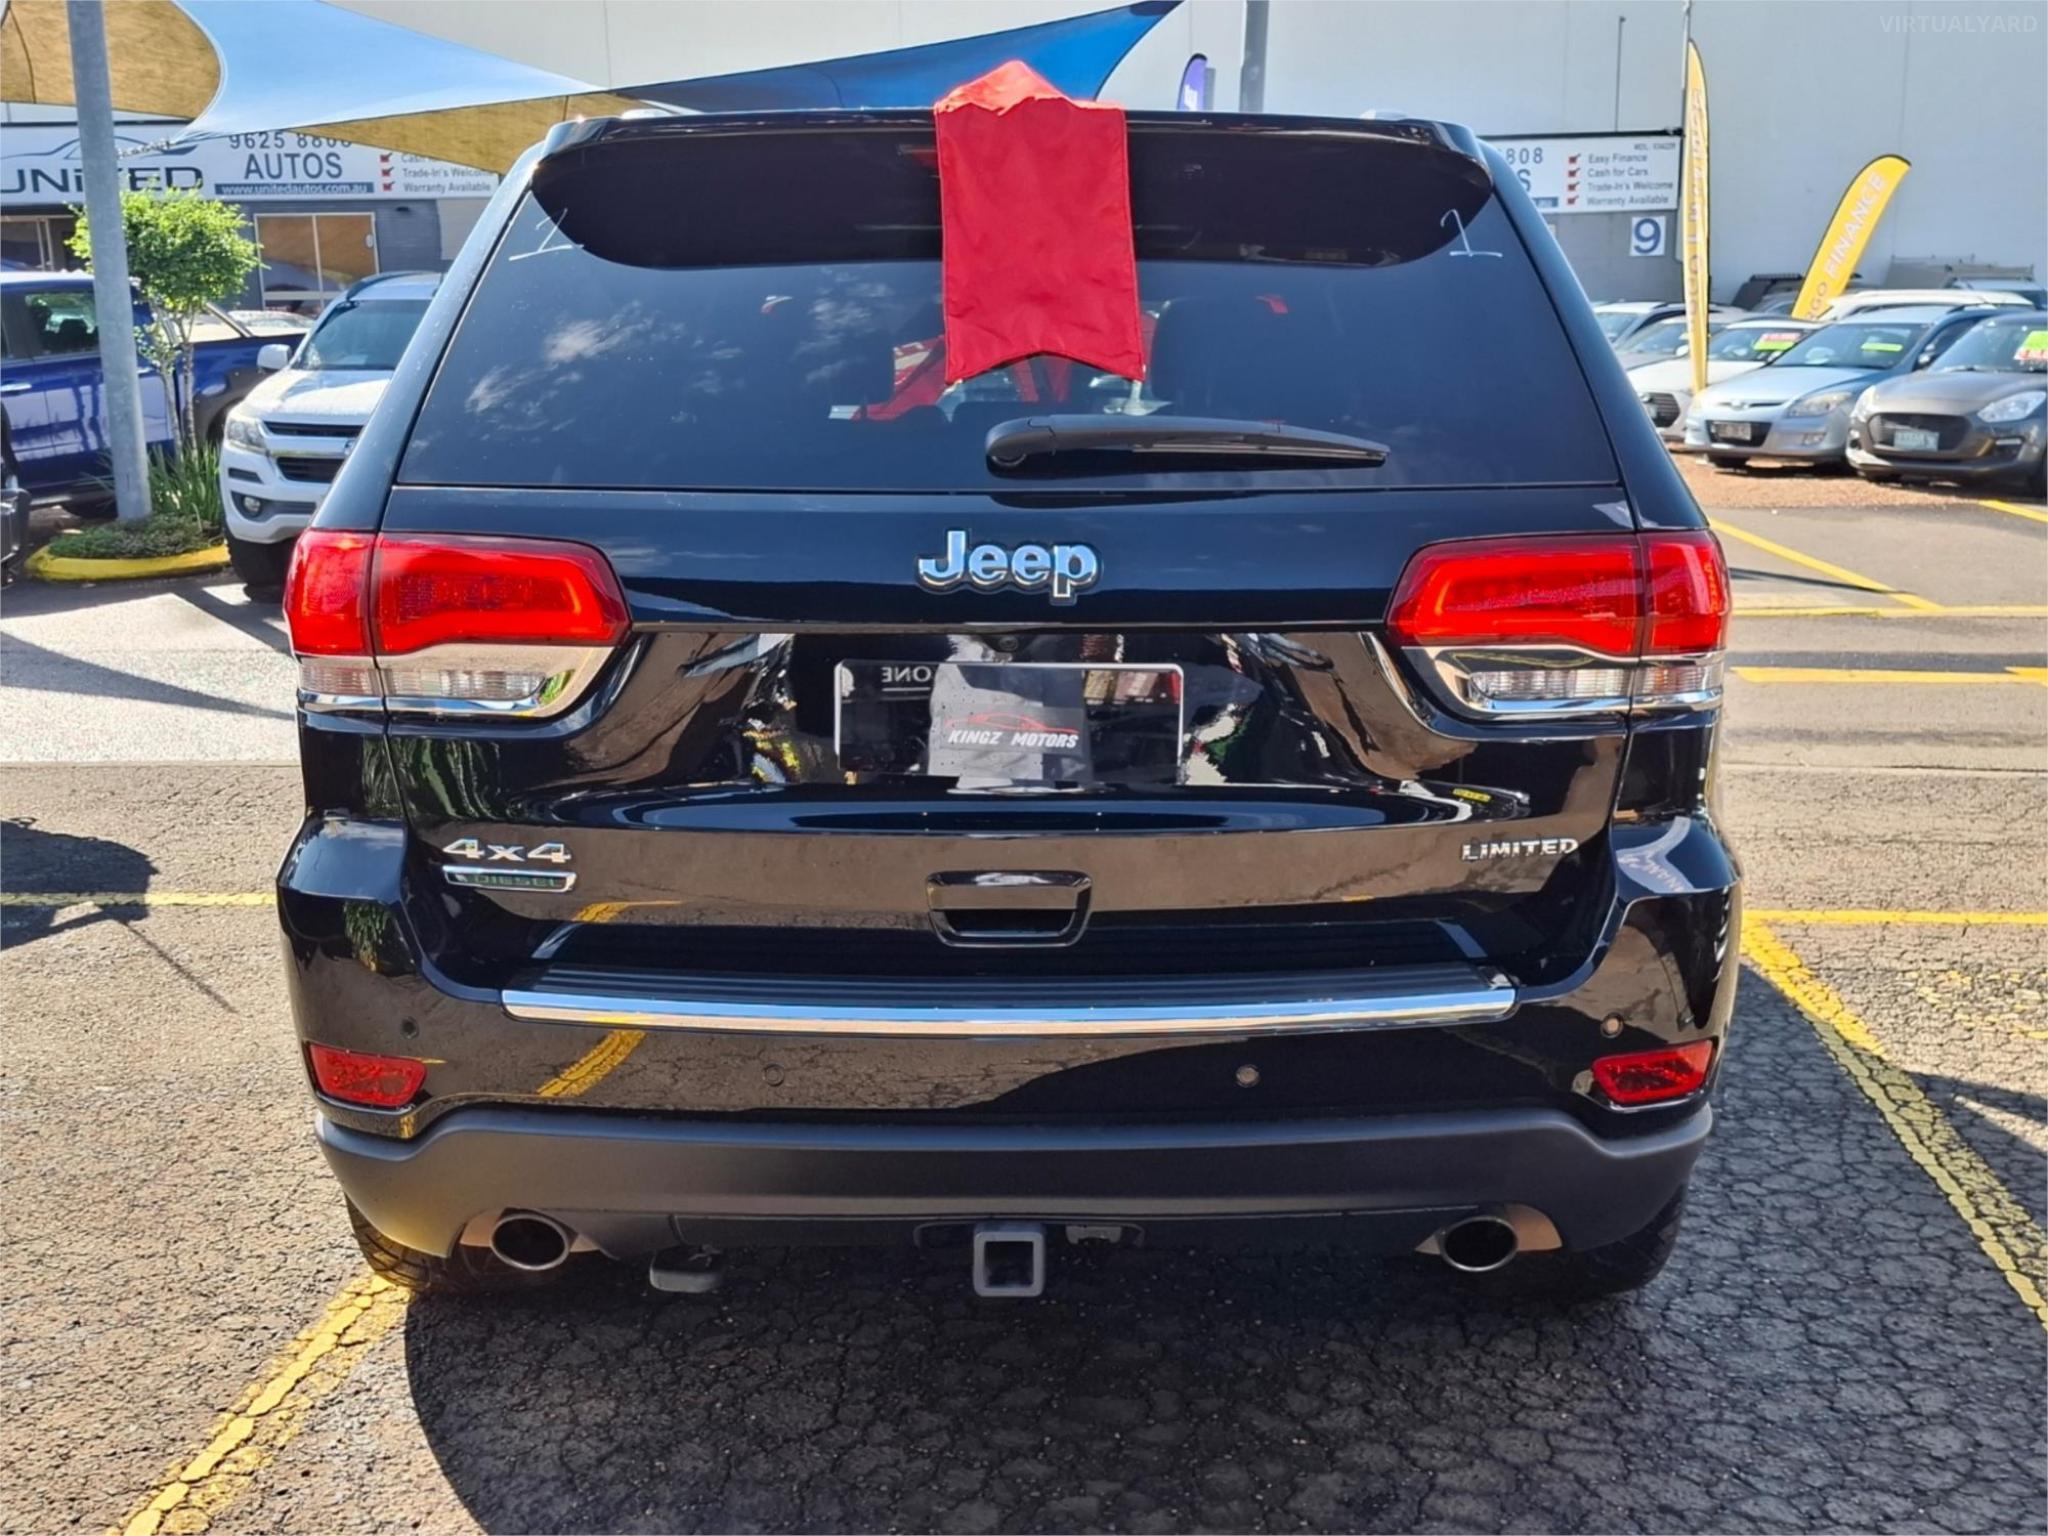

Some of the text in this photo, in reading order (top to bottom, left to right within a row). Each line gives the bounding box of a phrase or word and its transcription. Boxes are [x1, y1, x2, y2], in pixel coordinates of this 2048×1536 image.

[244, 152, 343, 180] AUTOS
[1612, 153, 1648, 163] Finance
[1587, 168, 1611, 178] Cash
[1627, 167, 1649, 177] Cars
[403, 181, 492, 195] Warranty Available
[1632, 181, 1674, 191] Welcome
[1628, 195, 1670, 205] Available
[1633, 217, 1662, 254] 9
[1824, 172, 1886, 280] FINANCE
[917, 530, 1098, 598] Jeep
[947, 729, 1079, 748] KINGZ MOTORS
[442, 838, 572, 863] 4x4
[1462, 838, 1579, 860] LIMITED
